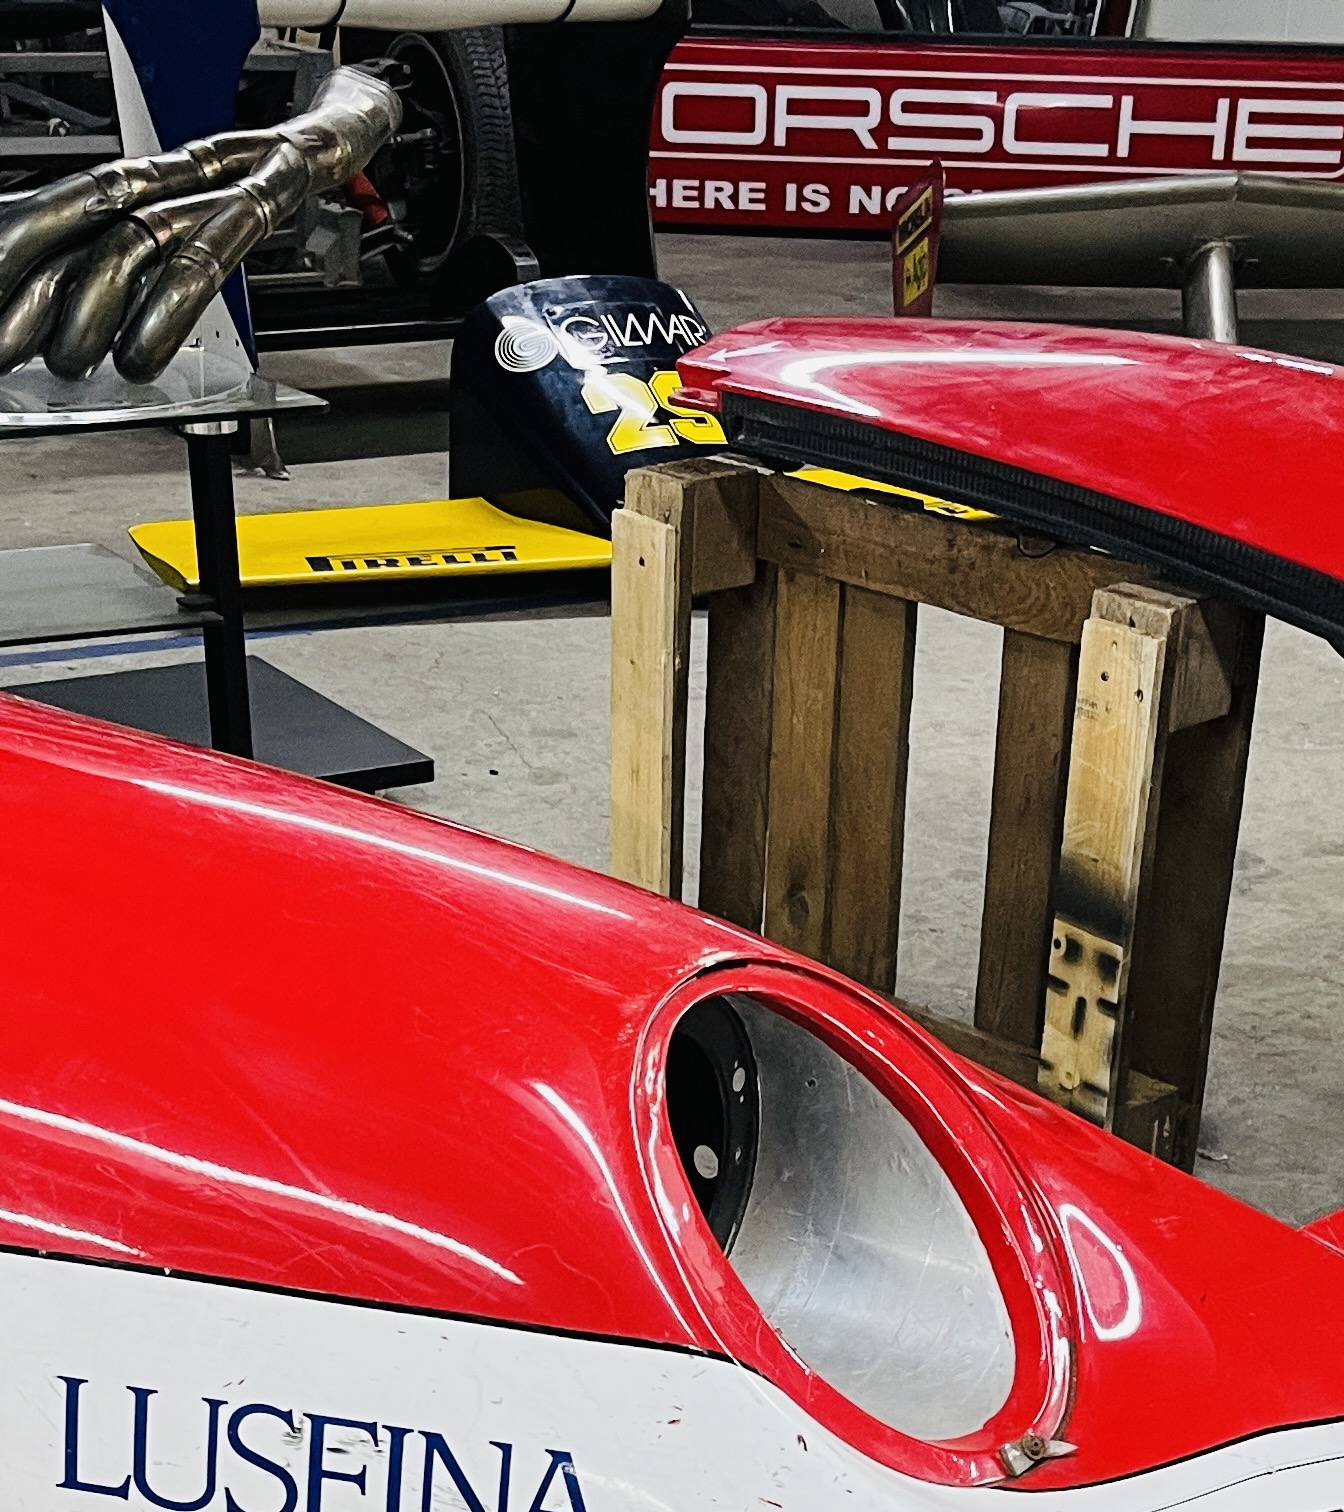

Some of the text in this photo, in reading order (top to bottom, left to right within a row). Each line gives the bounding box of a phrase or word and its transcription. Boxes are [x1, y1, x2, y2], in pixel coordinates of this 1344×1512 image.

[649, 179, 766, 211] HERE
[786, 181, 830, 213] IS
[560, 312, 707, 351] GILMAR
[305, 545, 516, 572] PIRELLI
